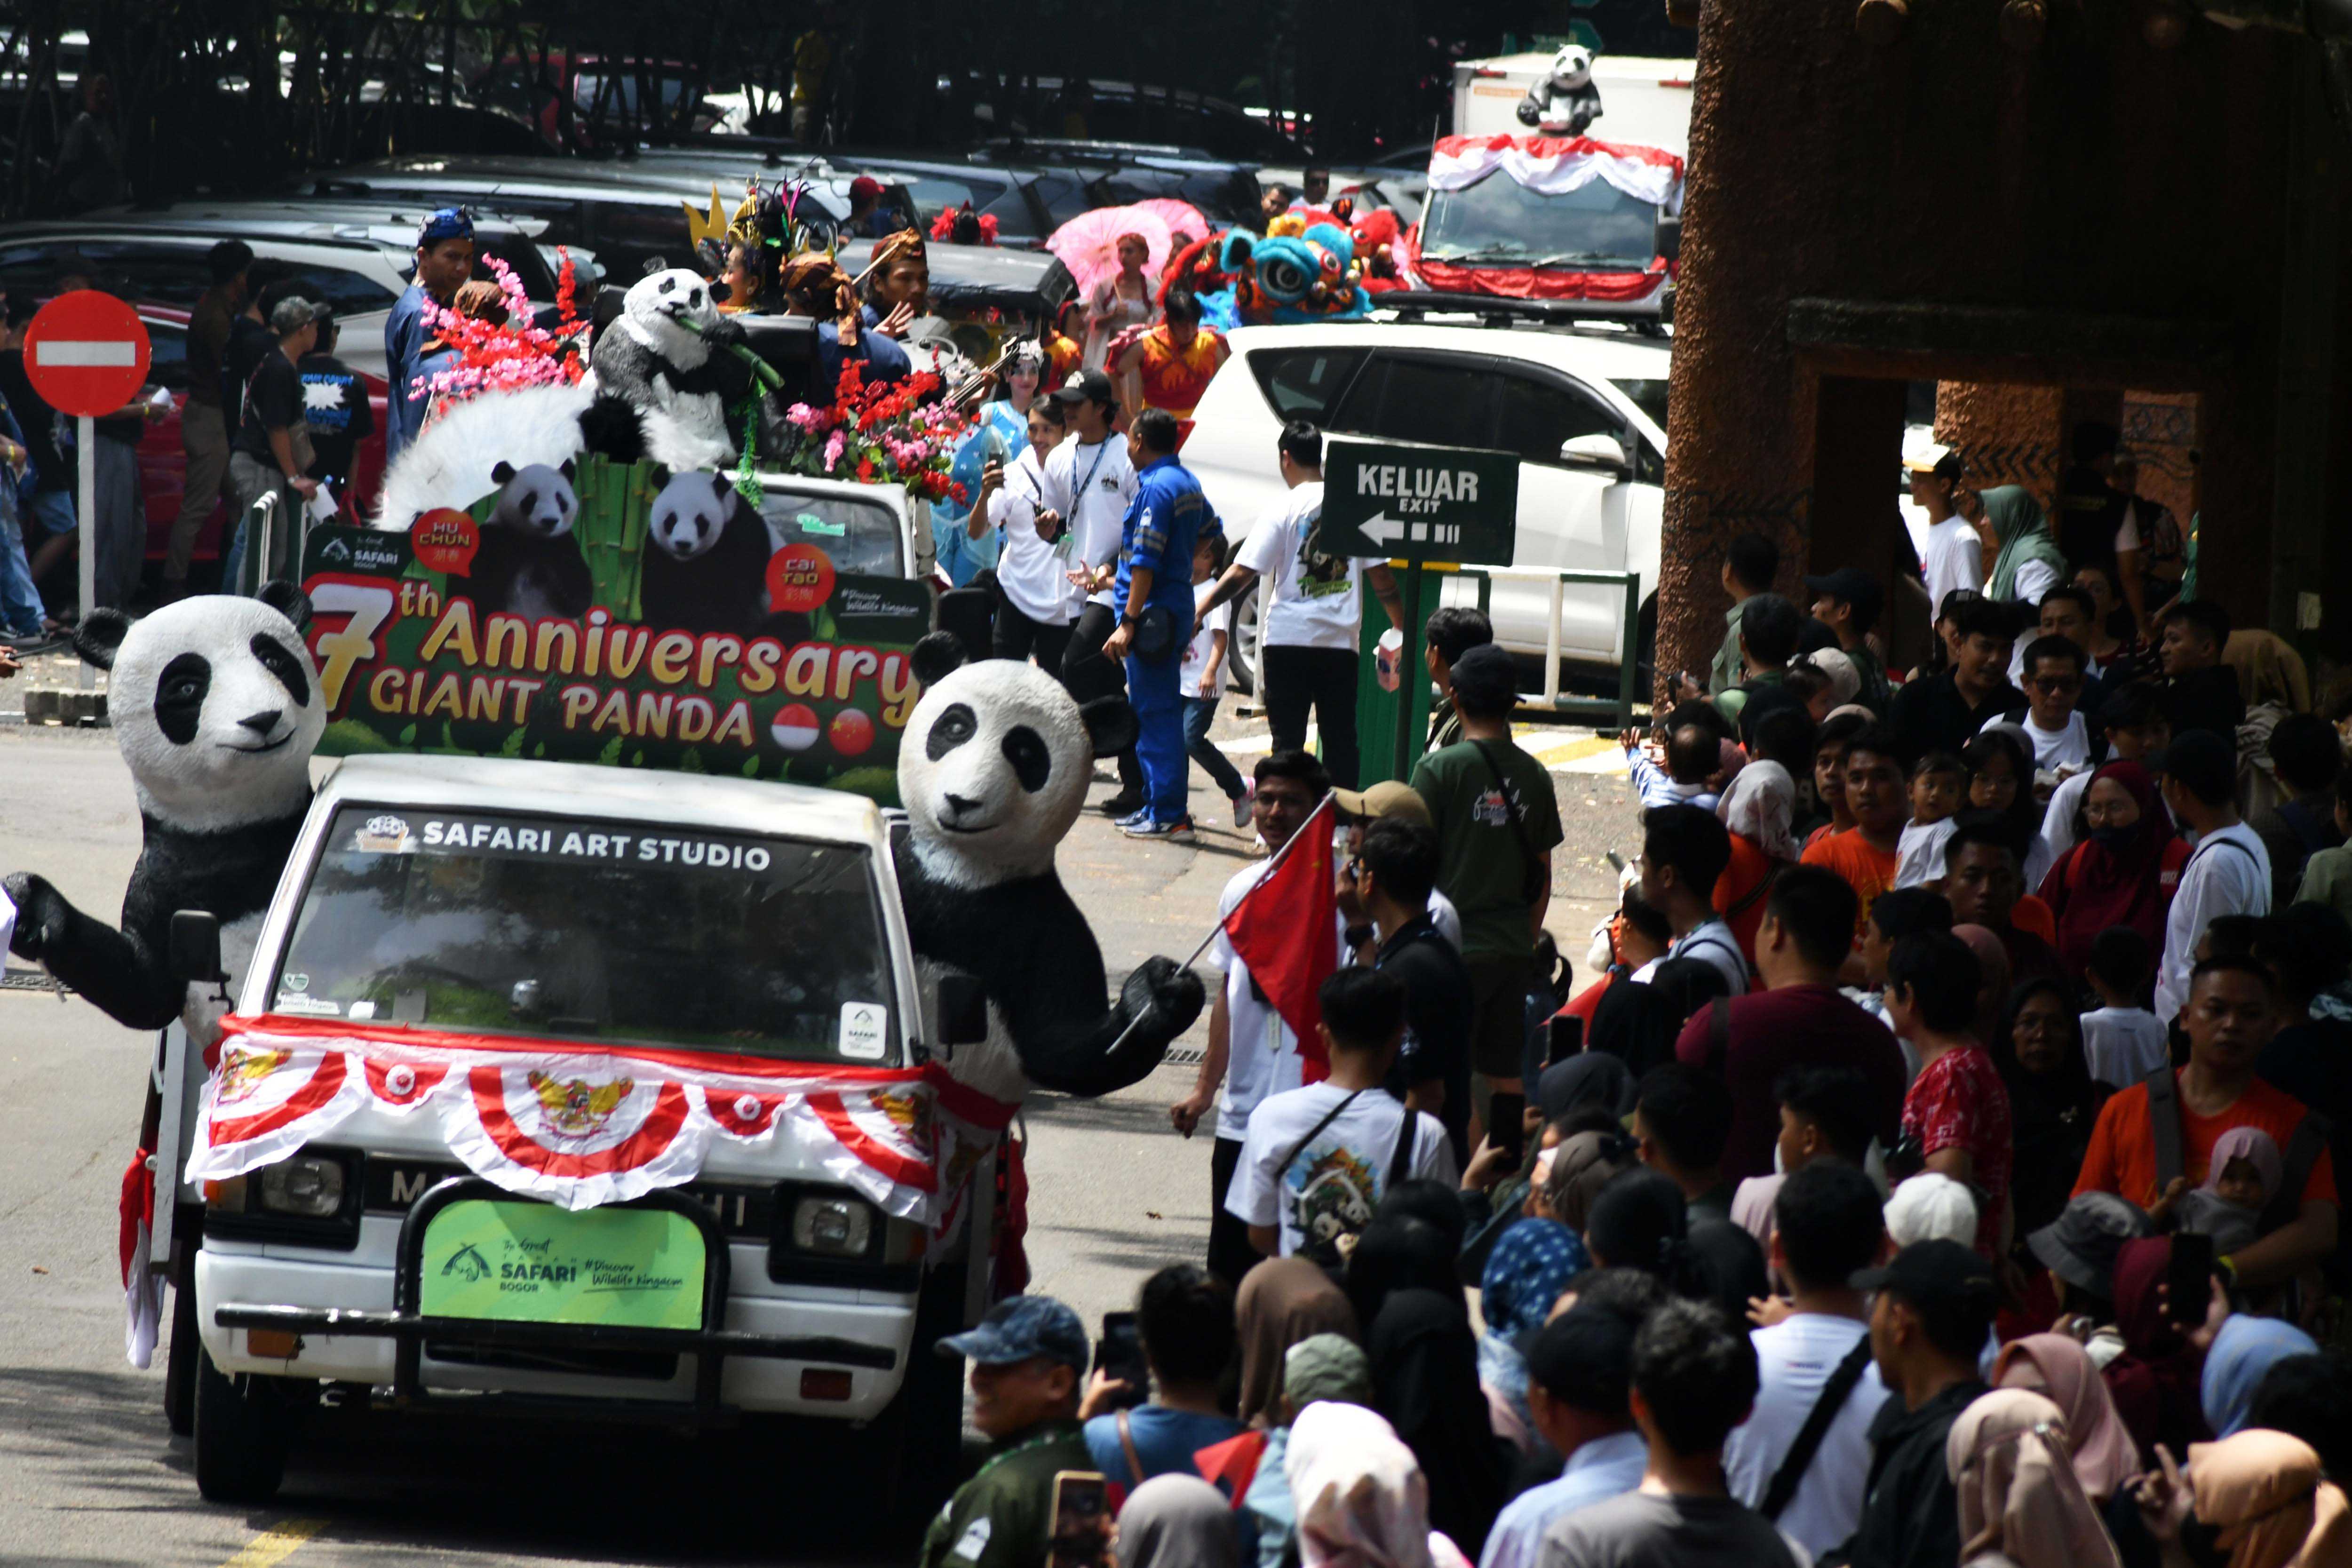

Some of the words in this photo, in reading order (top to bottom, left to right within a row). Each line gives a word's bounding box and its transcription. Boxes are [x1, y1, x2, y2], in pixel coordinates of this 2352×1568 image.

[1358, 464, 1478, 502] KELUAR
[1399, 498, 1441, 513] EXIT
[434, 522, 458, 533] HU
[419, 533, 470, 547] CHUN
[354, 549, 398, 565] SAFARI
[421, 601, 919, 727] Anniversary
[370, 668, 542, 724] GIANT
[561, 686, 753, 747] PANDA
[423, 821, 551, 852] SAFARI
[559, 832, 631, 859] ART
[637, 837, 771, 871] STUDIO
[501, 1263, 577, 1282] SAFARI
[592, 1273, 633, 1285] Wildlife
[500, 1281, 539, 1293] BOGOR
